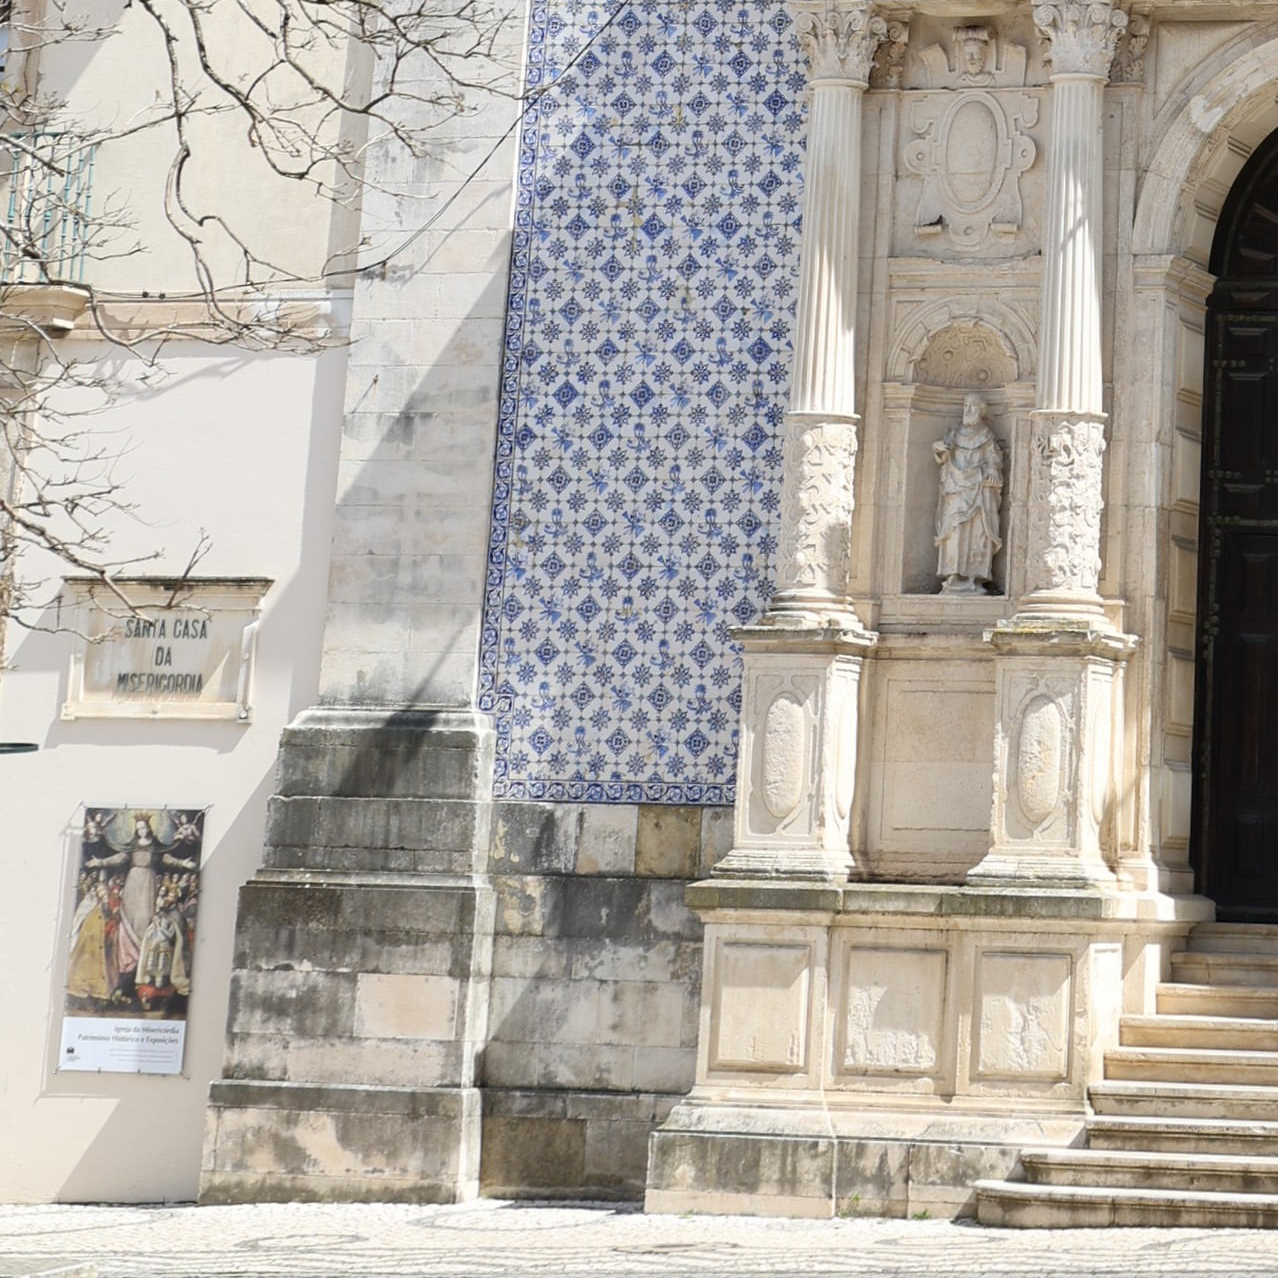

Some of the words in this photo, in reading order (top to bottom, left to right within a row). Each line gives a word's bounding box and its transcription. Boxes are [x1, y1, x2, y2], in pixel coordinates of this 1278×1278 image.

[125, 618, 166, 639] SANTA
[173, 619, 208, 640] CASA
[154, 646, 172, 666] DA
[116, 672, 203, 694] MISERICORDIA
